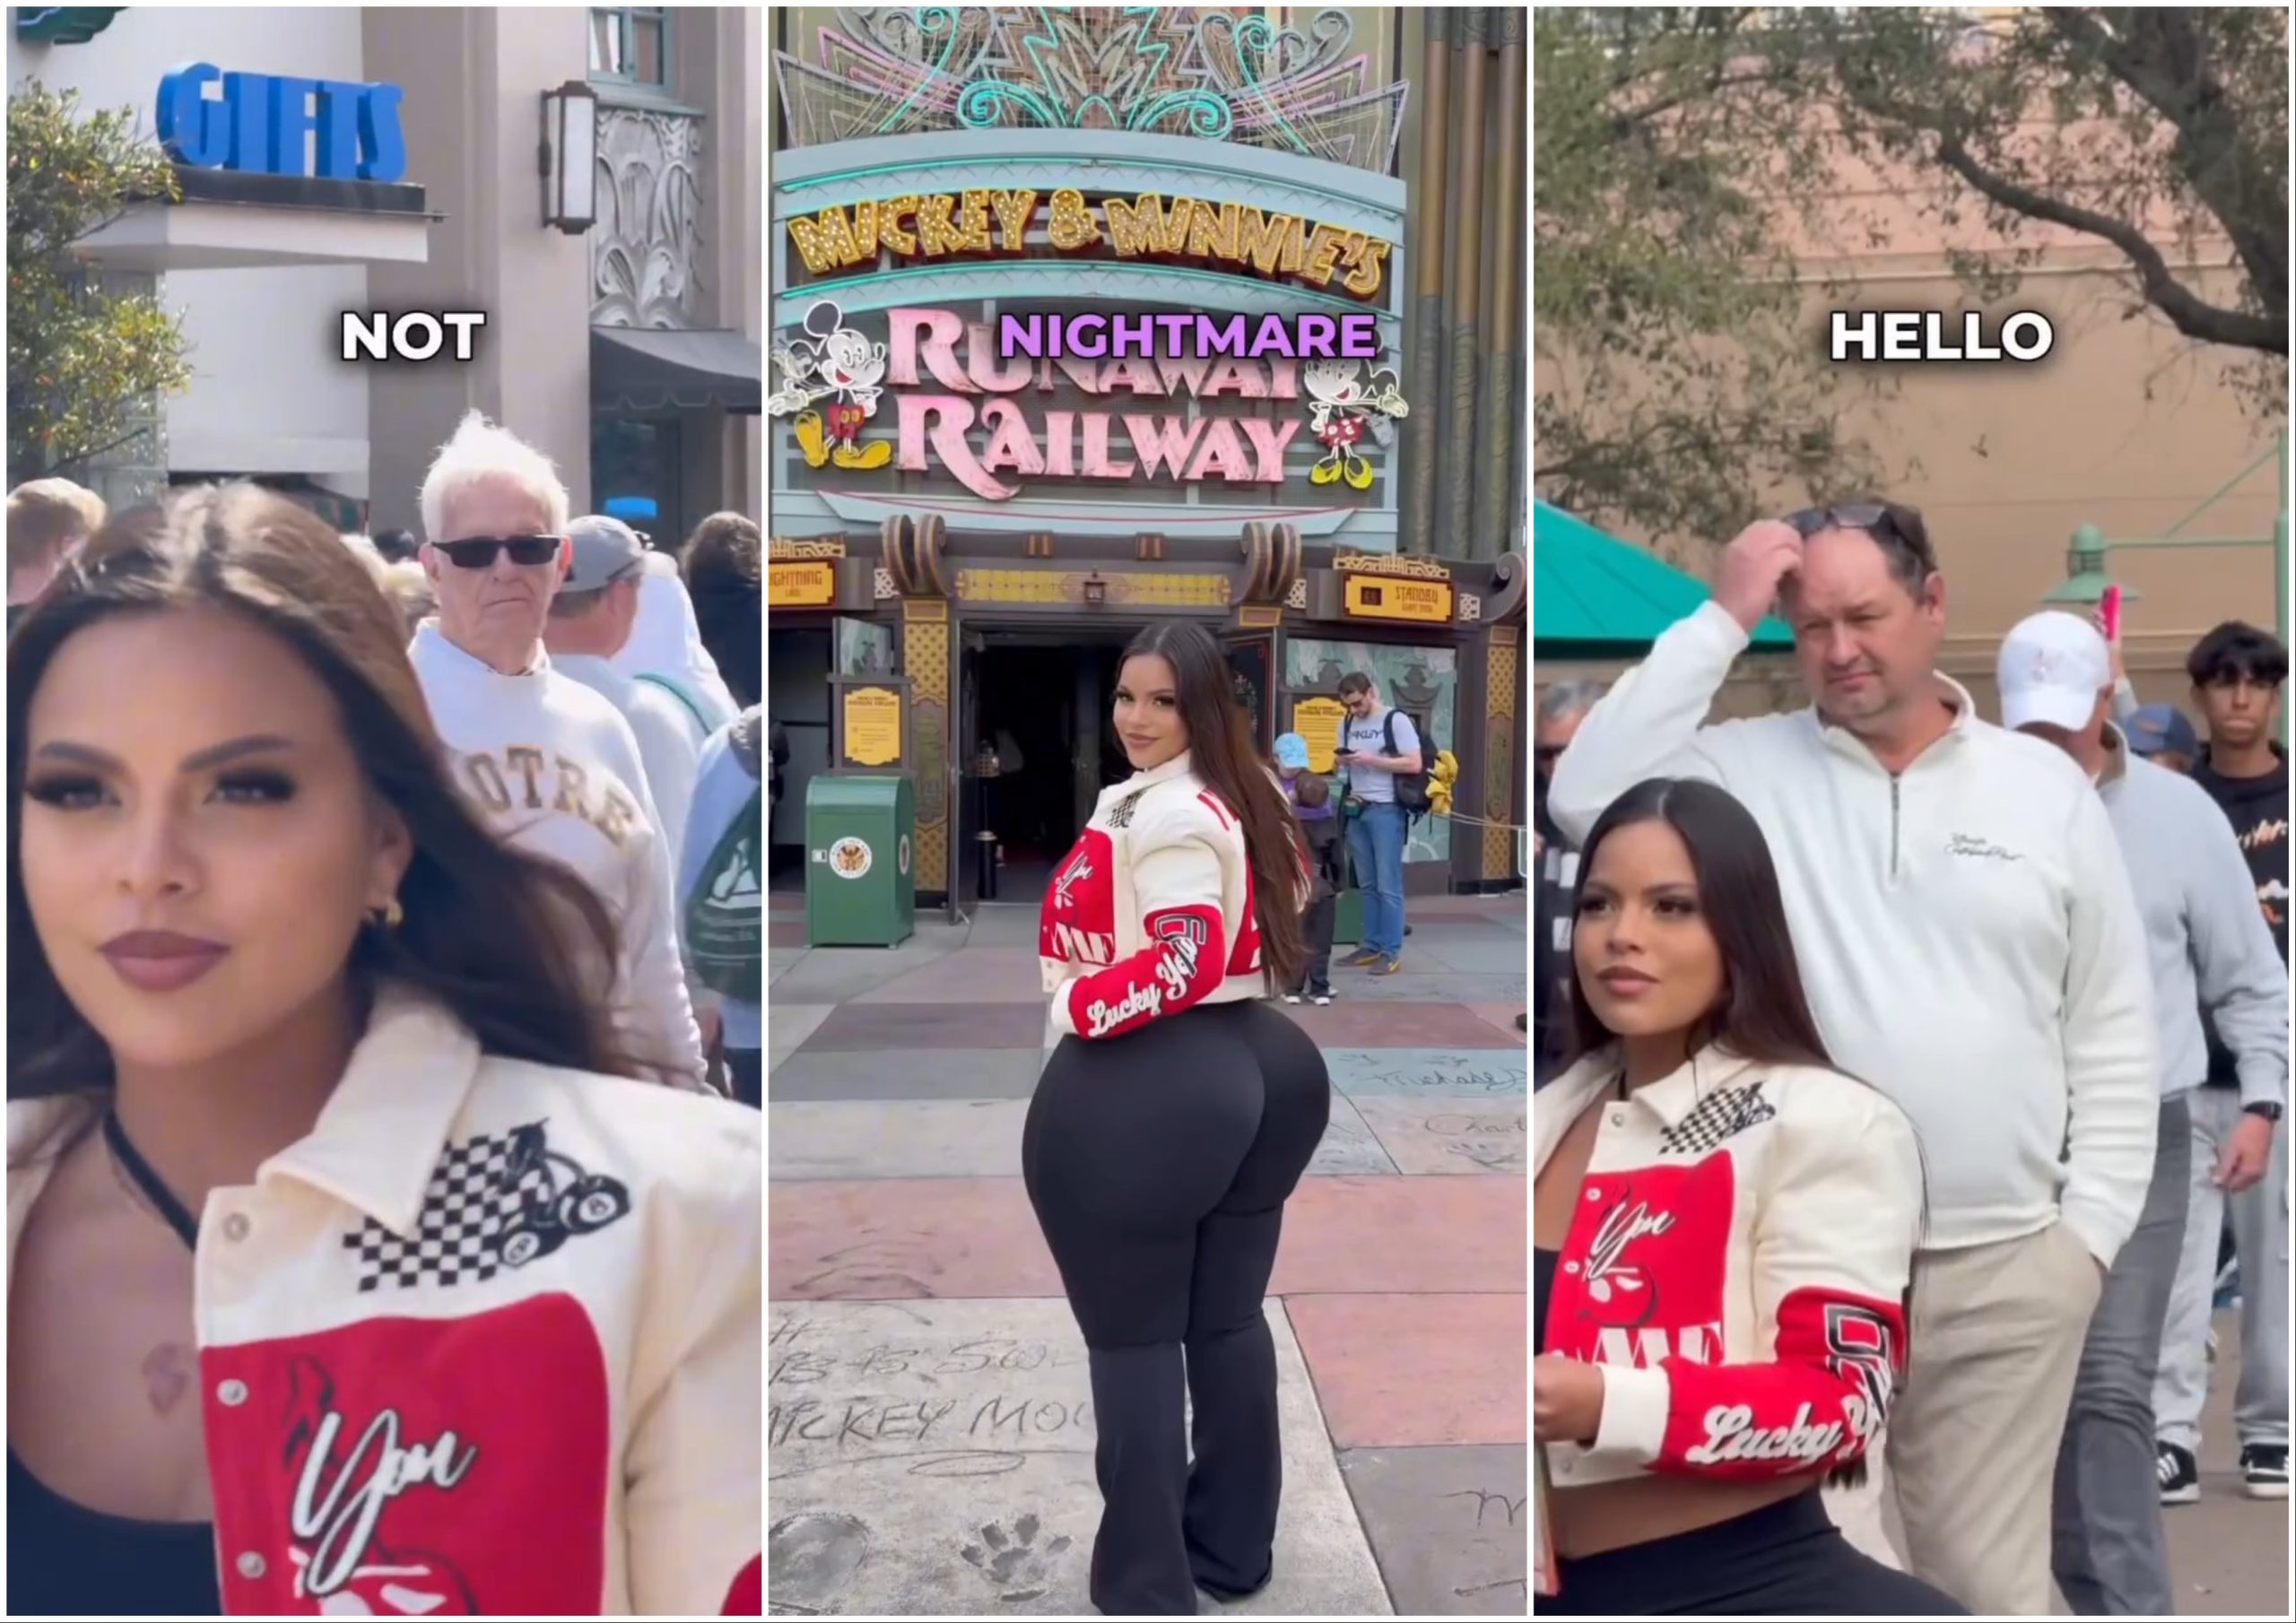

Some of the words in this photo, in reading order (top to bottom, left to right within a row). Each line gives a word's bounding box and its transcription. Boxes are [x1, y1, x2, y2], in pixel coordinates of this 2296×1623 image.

[156, 62, 407, 182] GIFTS
[787, 187, 1037, 275] MICKEY
[1048, 187, 1104, 251] &
[1102, 192, 1391, 296] MINNIE'S
[895, 395, 1301, 500] RAILWAY
[456, 742, 635, 847] OTRE
[1086, 981, 1162, 1037] Lucky
[1586, 1201, 1676, 1280] You
[1684, 1402, 1844, 1473] Lucky
[291, 1408, 477, 1597] You
